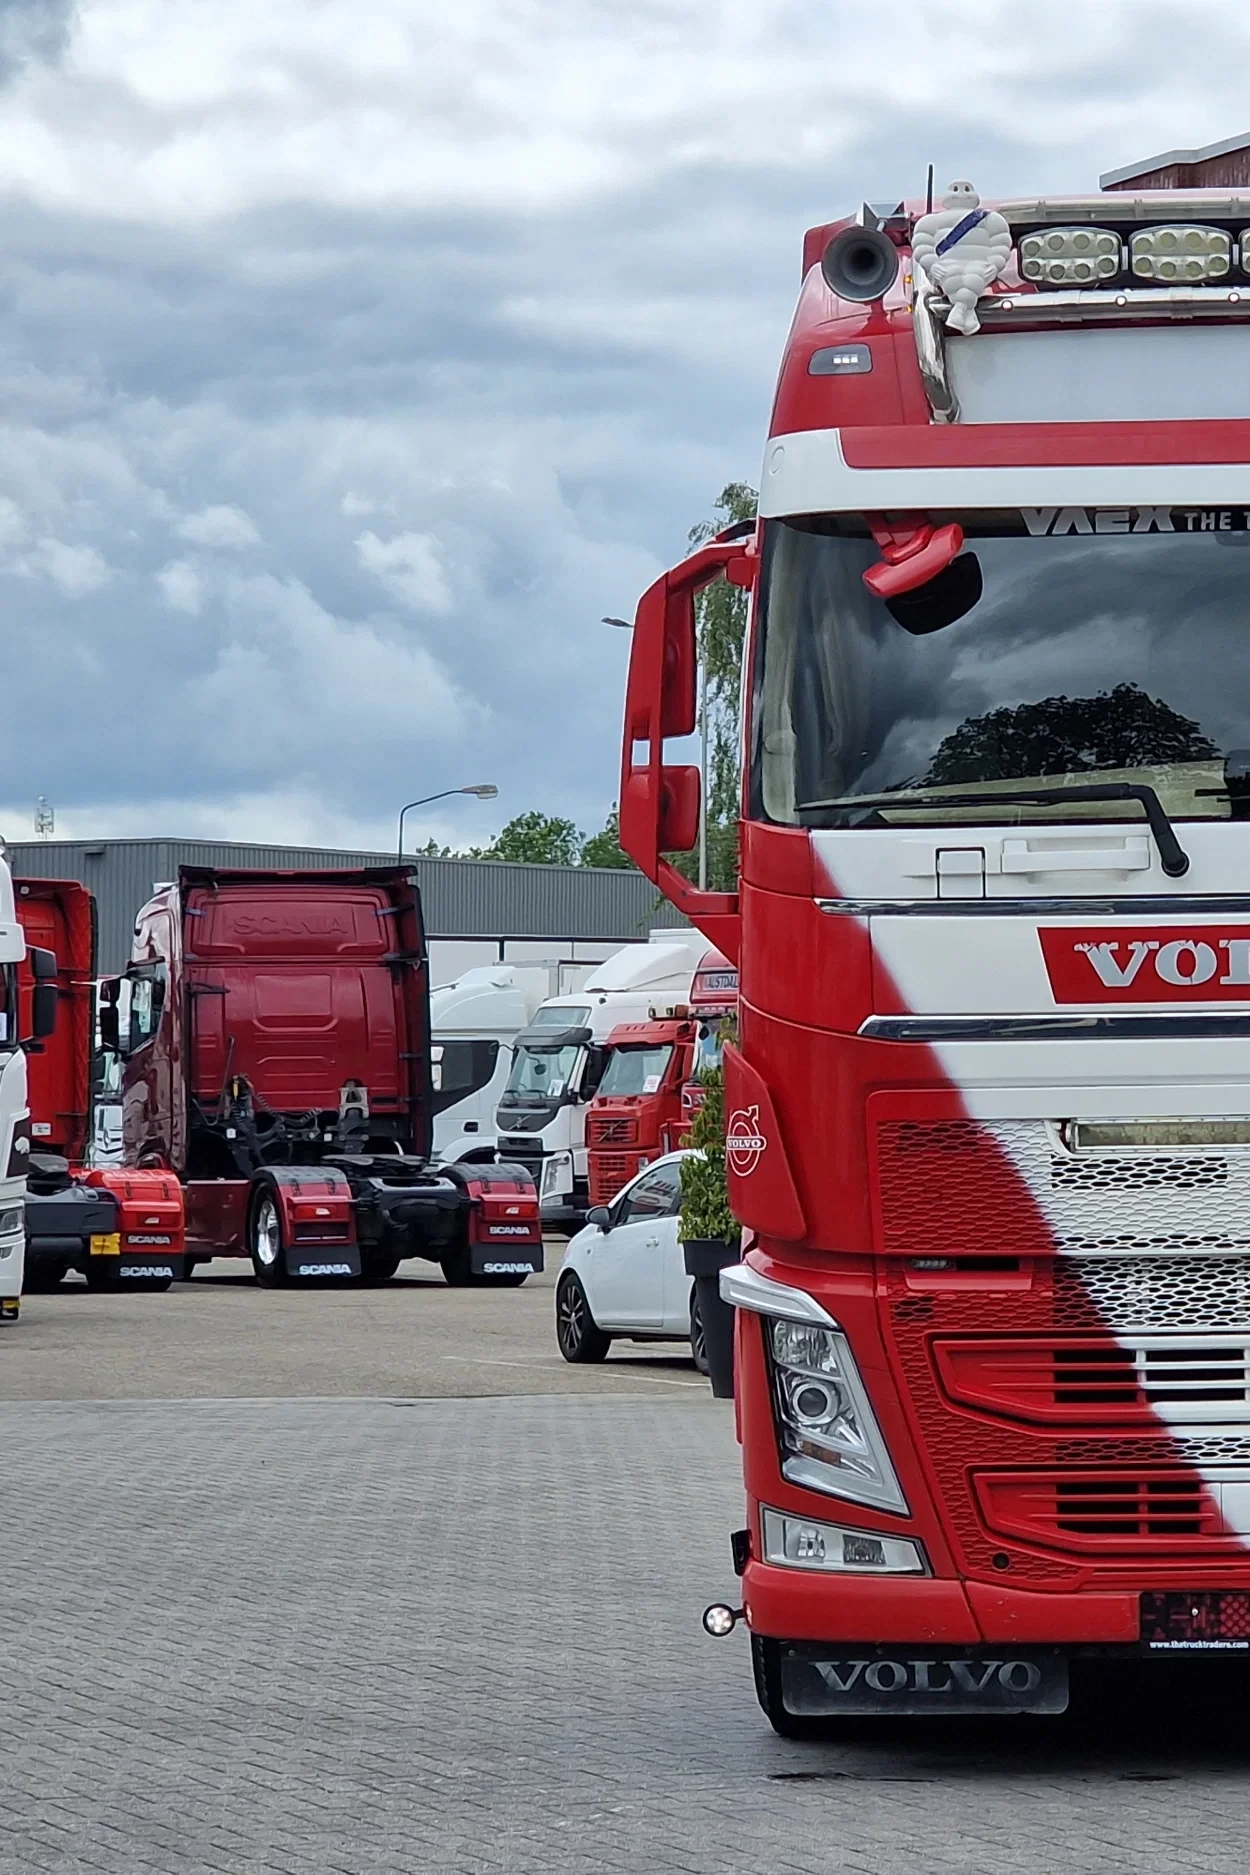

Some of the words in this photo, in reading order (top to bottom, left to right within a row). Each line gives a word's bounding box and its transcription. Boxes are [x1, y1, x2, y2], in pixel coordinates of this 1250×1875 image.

[1020, 506, 1175, 536] VAEX
[1184, 512, 1232, 530] THE
[233, 915, 348, 936] SCANIA
[728, 1139, 761, 1149] VOLVO
[489, 1226, 530, 1235] SCANIA
[128, 1235, 171, 1245] SCANIA
[119, 1266, 174, 1278] SCANIA
[299, 1264, 352, 1276] SCANIA
[483, 1263, 535, 1273] SCANIA
[808, 1660, 1042, 1692] VOLVO
